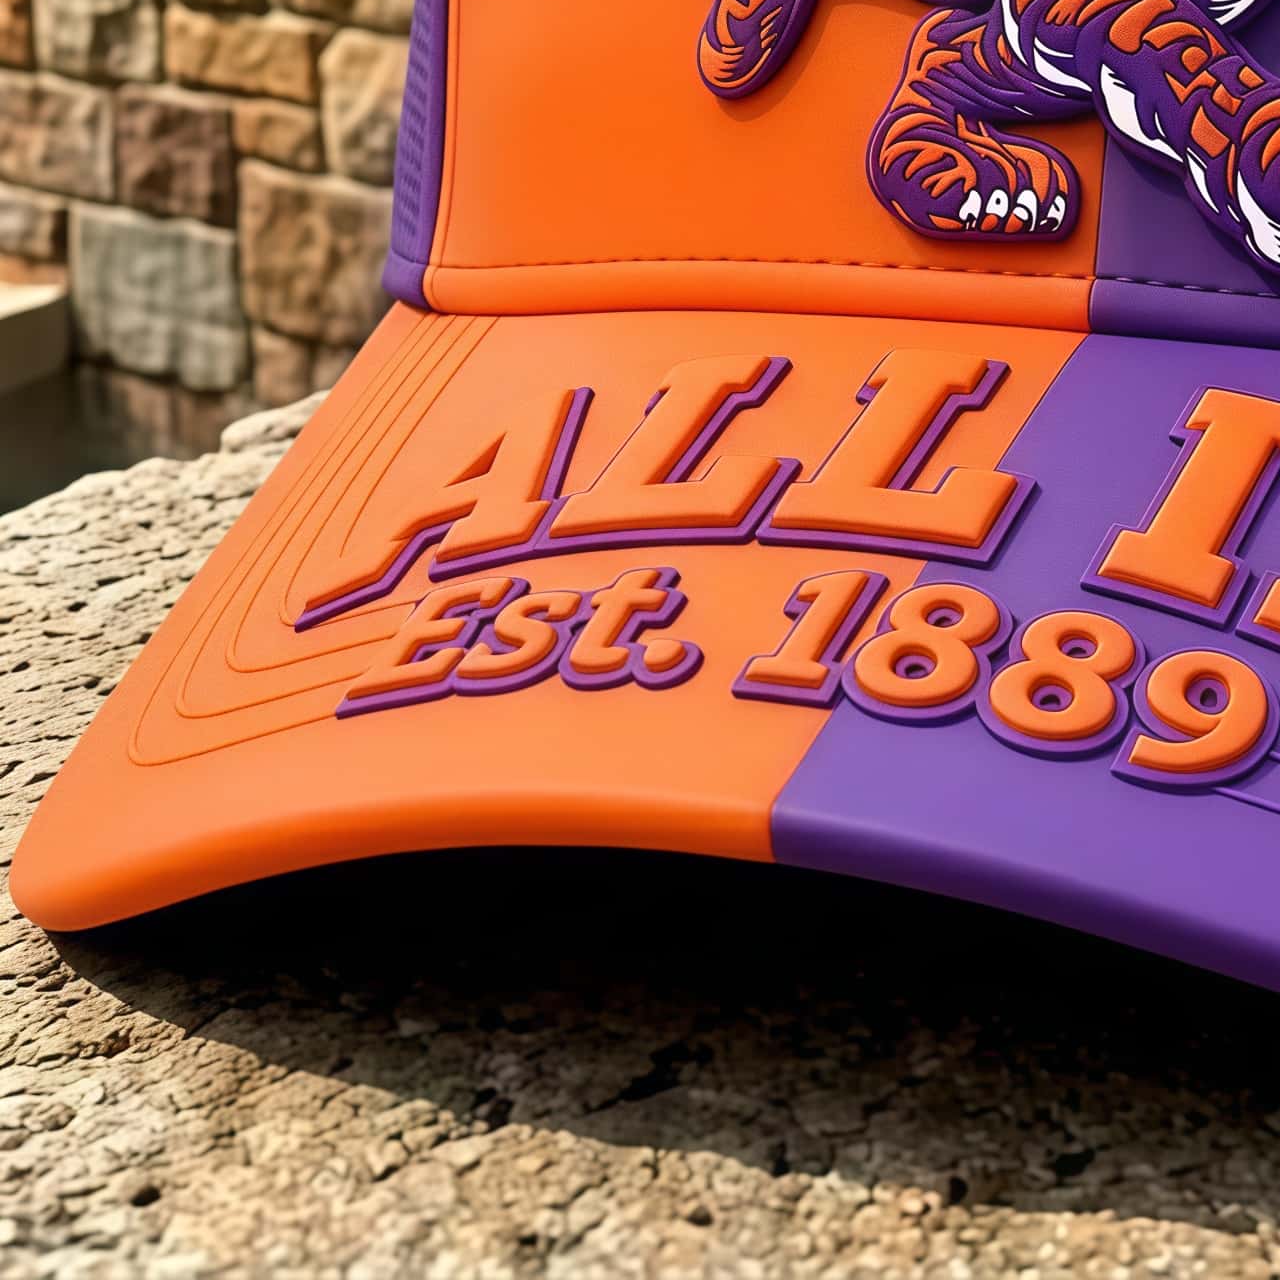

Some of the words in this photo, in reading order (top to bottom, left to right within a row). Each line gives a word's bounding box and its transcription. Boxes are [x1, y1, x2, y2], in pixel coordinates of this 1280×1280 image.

[295, 347, 1042, 632] ALL
[336, 566, 704, 719] Est.
[731, 570, 1280, 793] 1889
